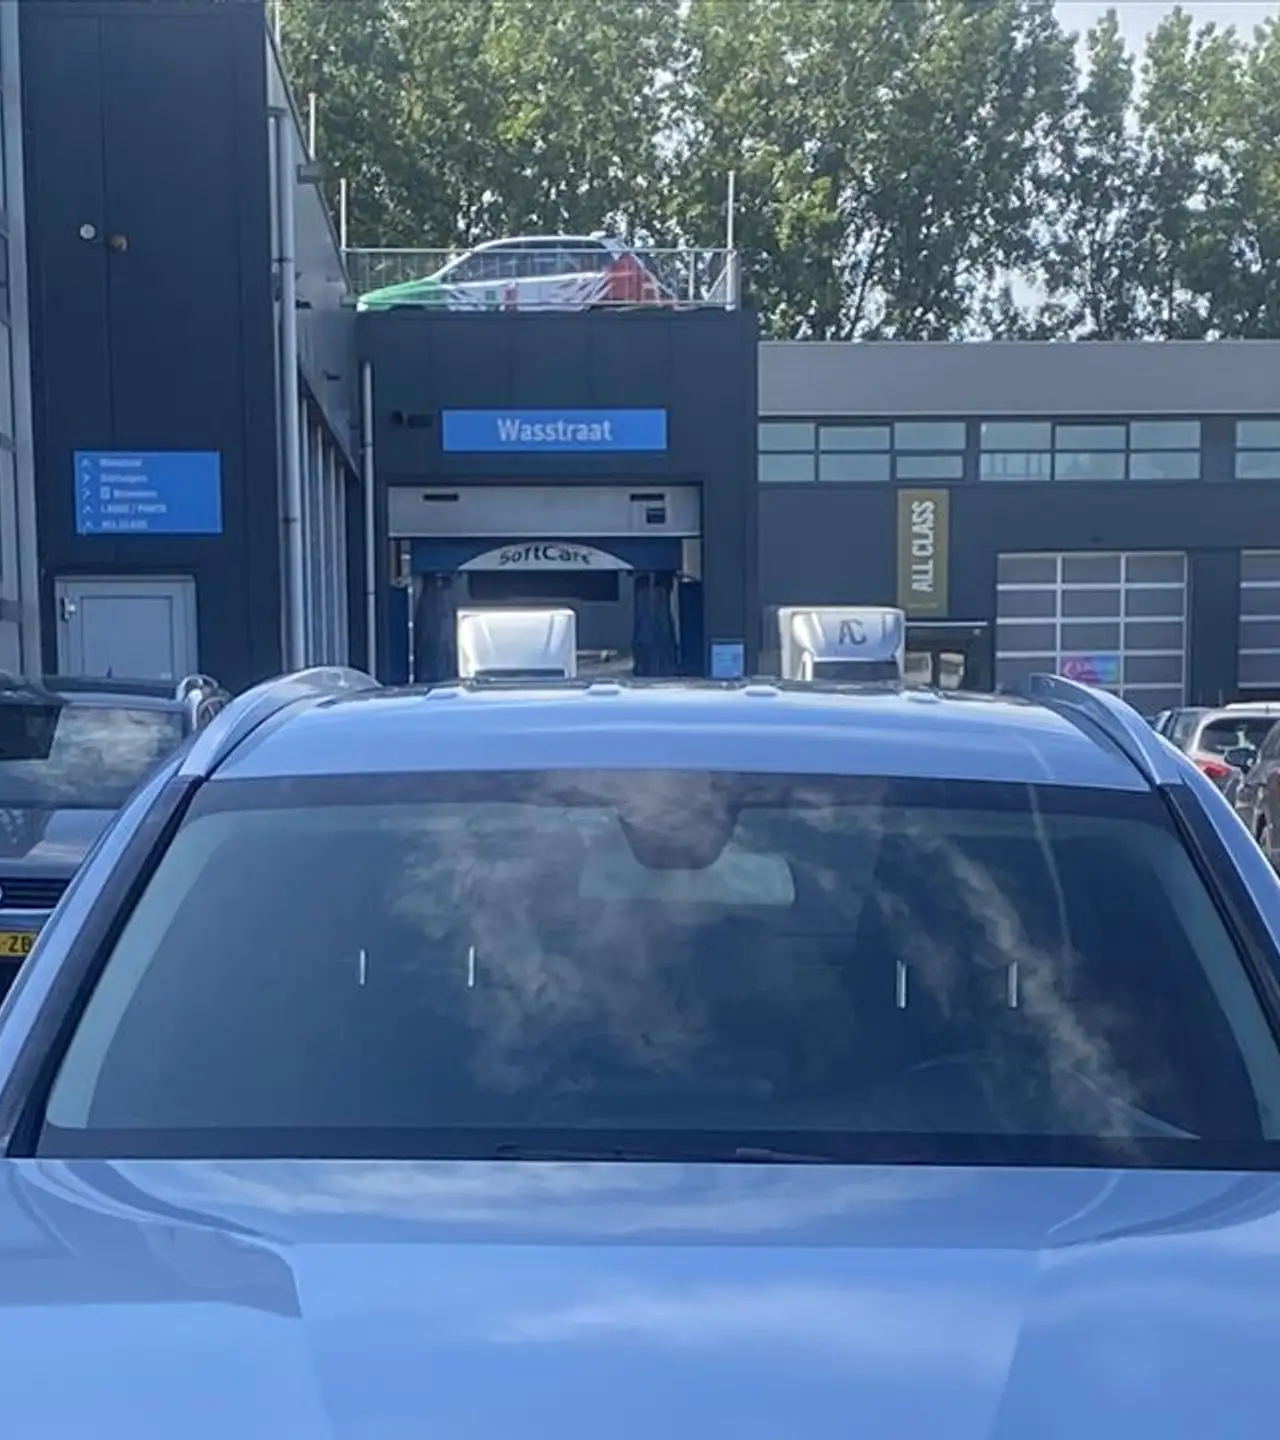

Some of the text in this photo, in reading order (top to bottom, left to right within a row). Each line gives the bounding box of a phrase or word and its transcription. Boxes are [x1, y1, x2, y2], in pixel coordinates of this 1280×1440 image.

[497, 417, 613, 441] Wasstraat
[911, 500, 936, 557] CLASS
[911, 558, 934, 592] ALL
